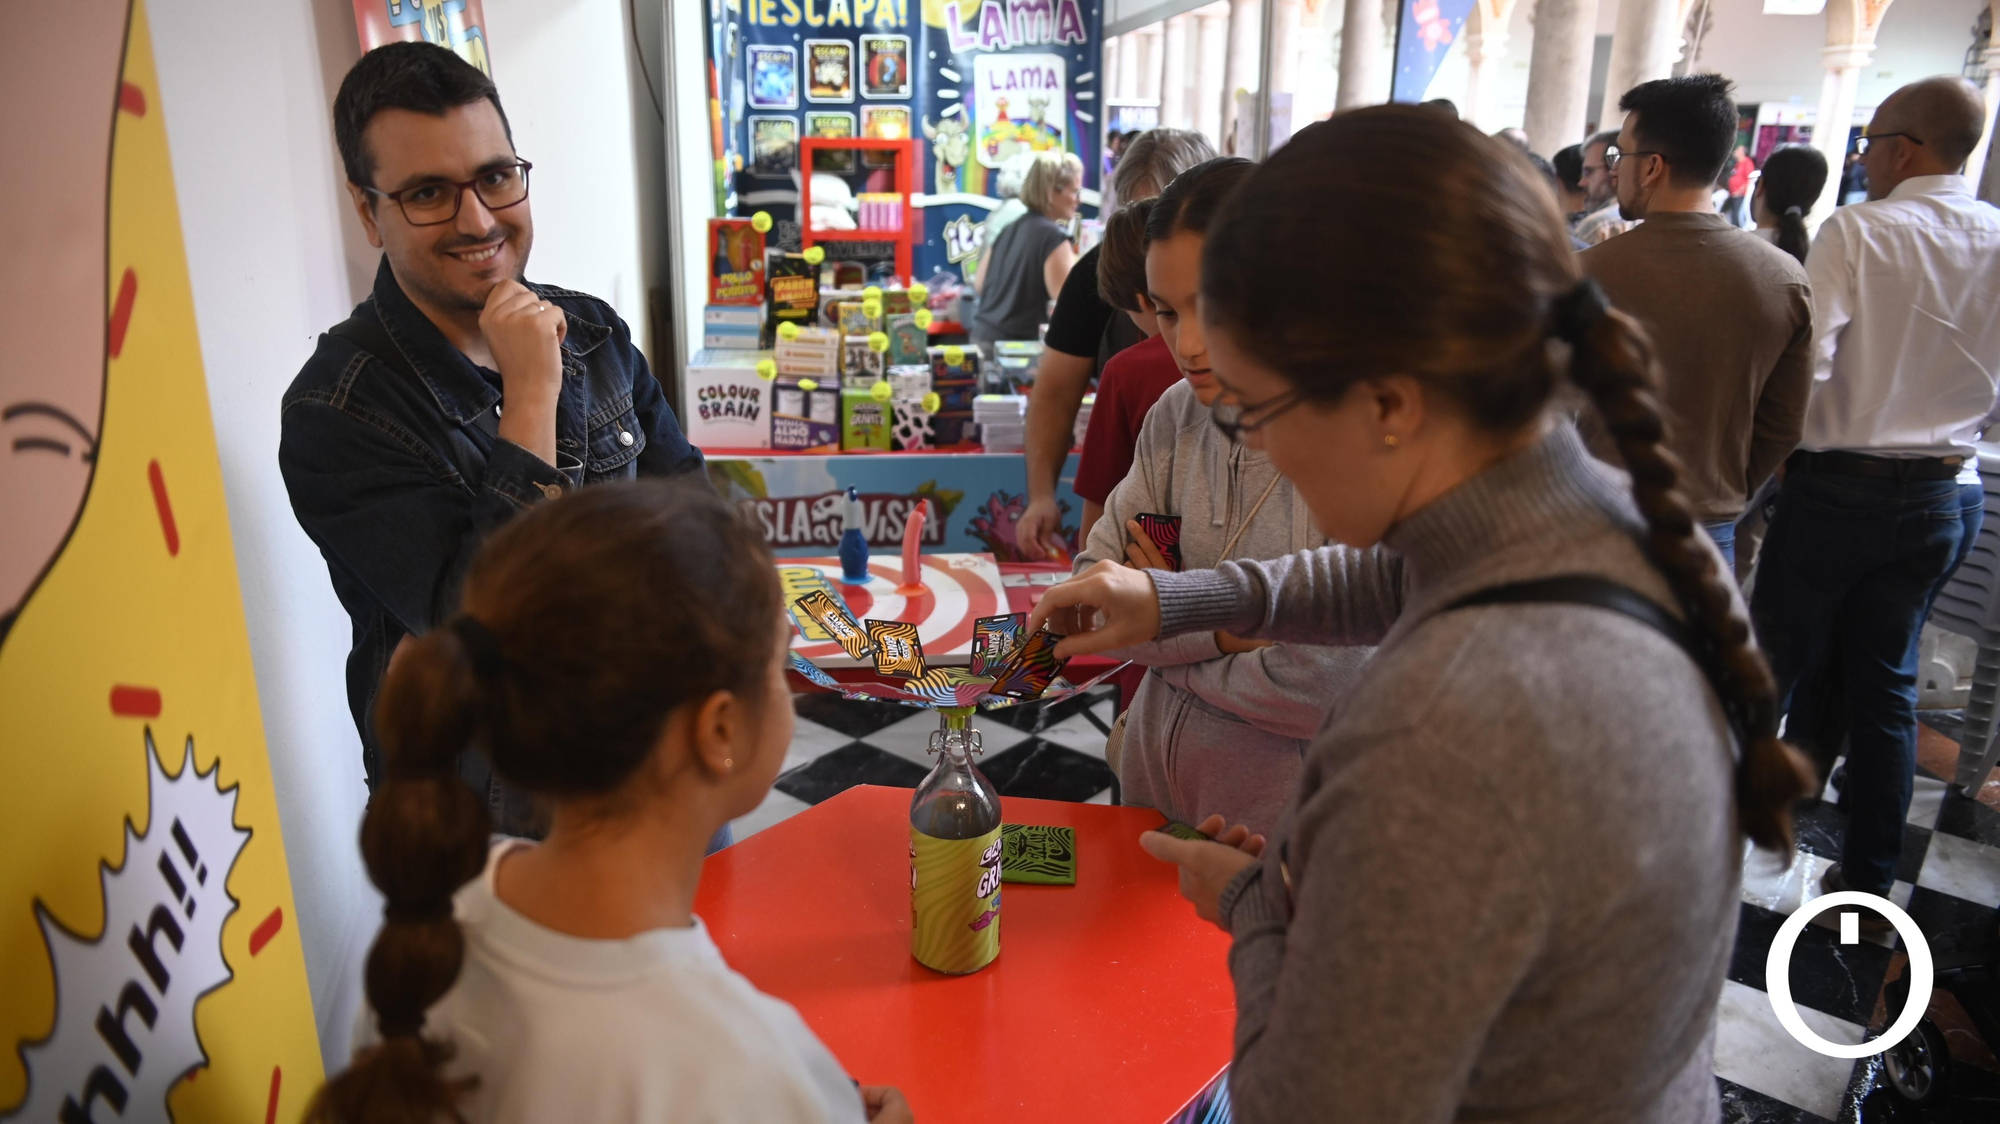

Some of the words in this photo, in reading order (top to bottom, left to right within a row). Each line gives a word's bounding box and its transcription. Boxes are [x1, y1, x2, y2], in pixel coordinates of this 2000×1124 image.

[946, 0, 1087, 52] LAMA
[988, 65, 1059, 90] LAMA
[697, 384, 760, 403] COLOUR
[698, 400, 760, 421] BRAIN
[748, 500, 811, 542] SLA
